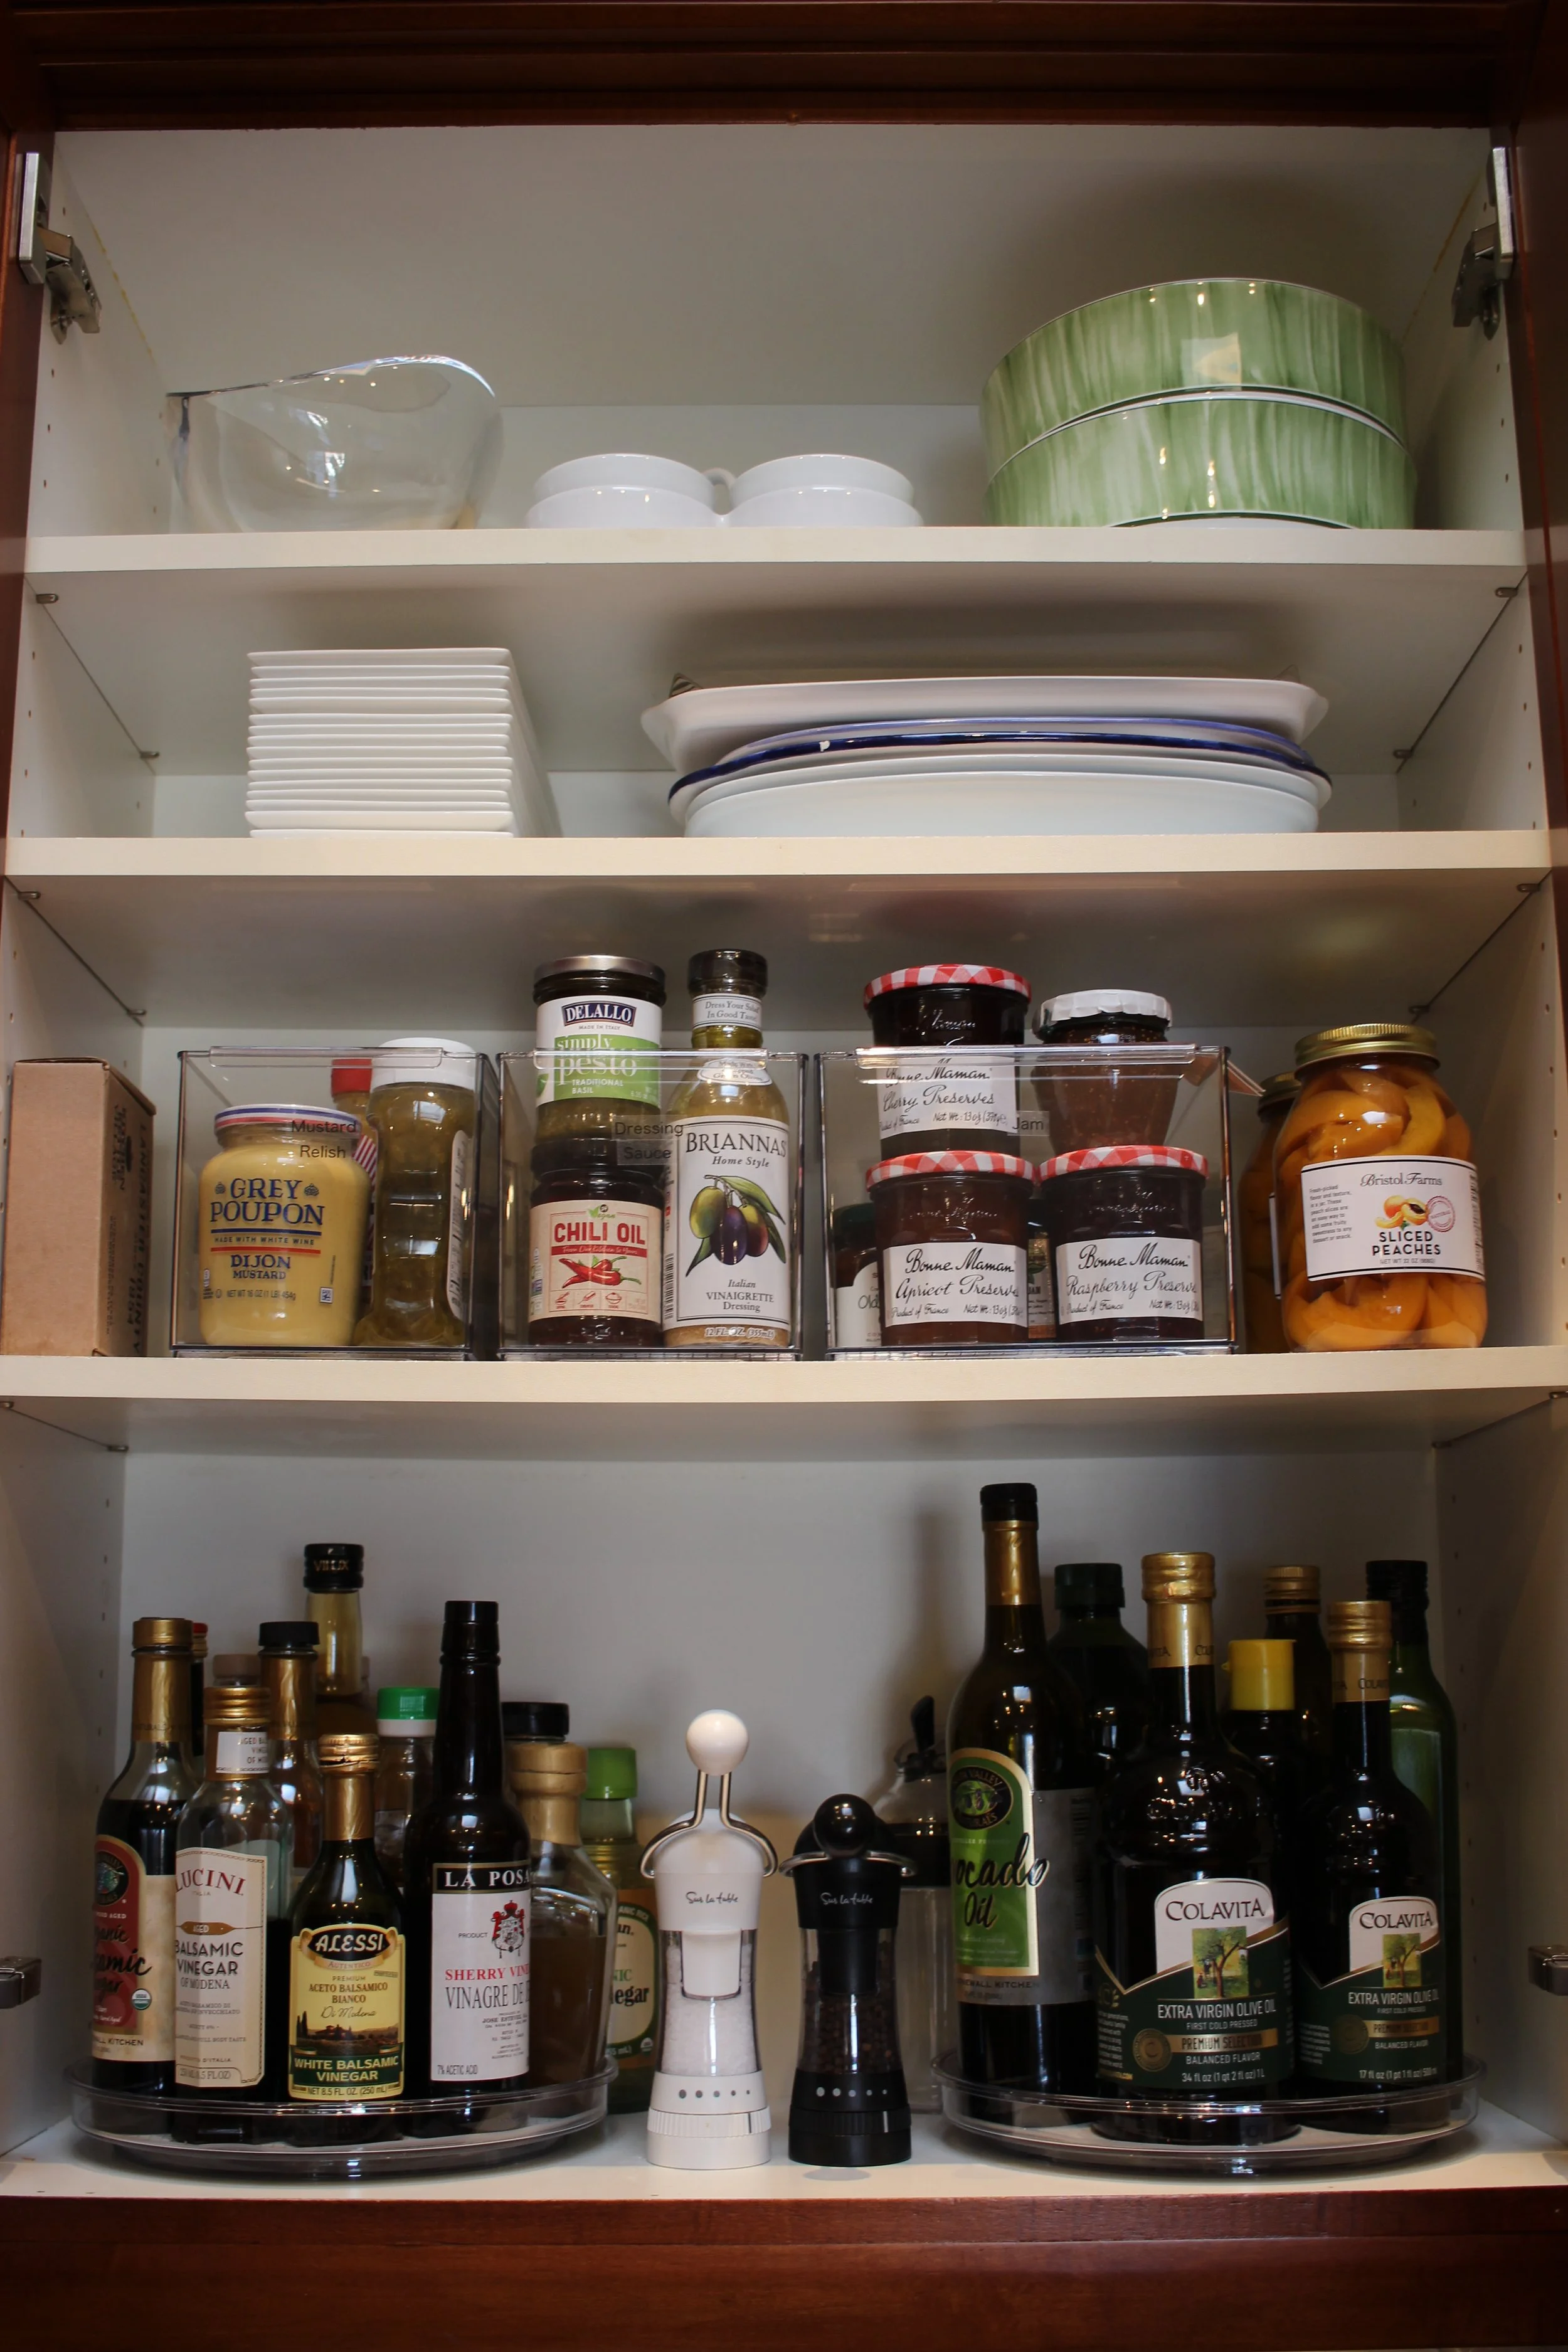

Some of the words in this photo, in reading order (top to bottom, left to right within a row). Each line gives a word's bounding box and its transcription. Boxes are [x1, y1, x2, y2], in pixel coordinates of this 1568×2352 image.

[726, 1001, 743, 1009] Your
[566, 1004, 632, 1024] DELALLO
[716, 1010, 738, 1019] Good
[925, 1058, 991, 1079] Maman
[572, 1078, 623, 1087] TRADITIONAL
[923, 1084, 996, 1105] Preserves
[291, 1120, 357, 1133] Mustard
[615, 1122, 684, 1136] Dressing
[1012, 1119, 1044, 1130] Jam
[300, 1145, 346, 1158] Relish
[686, 1133, 787, 1158] BRIANNAS
[623, 1147, 671, 1159] Sauce
[712, 1156, 743, 1165] Home
[746, 1156, 770, 1168] Style
[1360, 1172, 1403, 1187] Bristol
[1404, 1172, 1442, 1186] Farms
[230, 1178, 302, 1199] GREY
[209, 1200, 326, 1226] POUPON
[554, 1222, 608, 1242] CHILI
[617, 1223, 645, 1245] OIL
[1379, 1231, 1433, 1242] SLICED
[1078, 1244, 1128, 1269] Bonne
[1130, 1242, 1189, 1268] Maman
[1372, 1244, 1441, 1256] PEACHES
[230, 1254, 291, 1269] DIJON
[905, 1248, 953, 1273] Bonne
[955, 1247, 1014, 1273] Maman
[233, 1270, 287, 1279] MUSTARD
[728, 1279, 756, 1288] Italian
[1066, 1274, 1139, 1302] Raspberry
[706, 1292, 774, 1303] VINAIGRETTE
[896, 1278, 955, 1304] Apricot
[723, 1301, 761, 1313] Dressing
[706, 1328, 714, 1336] 12
[176, 1868, 246, 1896] LUCINI
[445, 1871, 476, 1887] LA
[965, 1891, 998, 1930] Oil
[1165, 1898, 1266, 1921] COLAVITA
[1359, 1910, 1433, 1929] COLAVITA
[176, 1940, 243, 1957] BALSAMIC
[315, 1934, 383, 1952] ALESSI
[177, 1959, 238, 1975] VINEGAR
[445, 1968, 506, 1980] SHERRY
[309, 1984, 336, 1993] ACETO
[339, 1982, 388, 1993] BALSAMICO
[332, 1994, 366, 2004] BIANCO
[445, 1984, 508, 2009] VINAGRE
[512, 1982, 524, 2006] DE
[1348, 1992, 1379, 2005] EXTRA
[1380, 1992, 1412, 2005] VIRGIN
[1413, 1990, 1432, 2003] OLIVE
[1158, 2005, 1194, 2018] EXTRA
[1195, 2003, 1234, 2018] VIRGIN
[1236, 2000, 1263, 2016] OLIVE
[1264, 1998, 1276, 2013] OIL
[1186, 2021, 1207, 2030] FIRST
[1209, 2021, 1227, 2030] COLD
[1229, 2019, 1258, 2028] PRESSED
[1182, 2037, 1220, 2050] PREMIUM
[1375, 2042, 1408, 2050] BALANCED
[294, 2058, 333, 2069] WHITE
[336, 2055, 400, 2070] BALSAMIC
[1186, 2055, 1231, 2064] BALANCED
[1233, 2052, 1260, 2063] FLAVOR
[316, 2070, 378, 2082] VINEGAR
[1182, 2072, 1192, 2082] 34
[1202, 2074, 1212, 2082] oz
